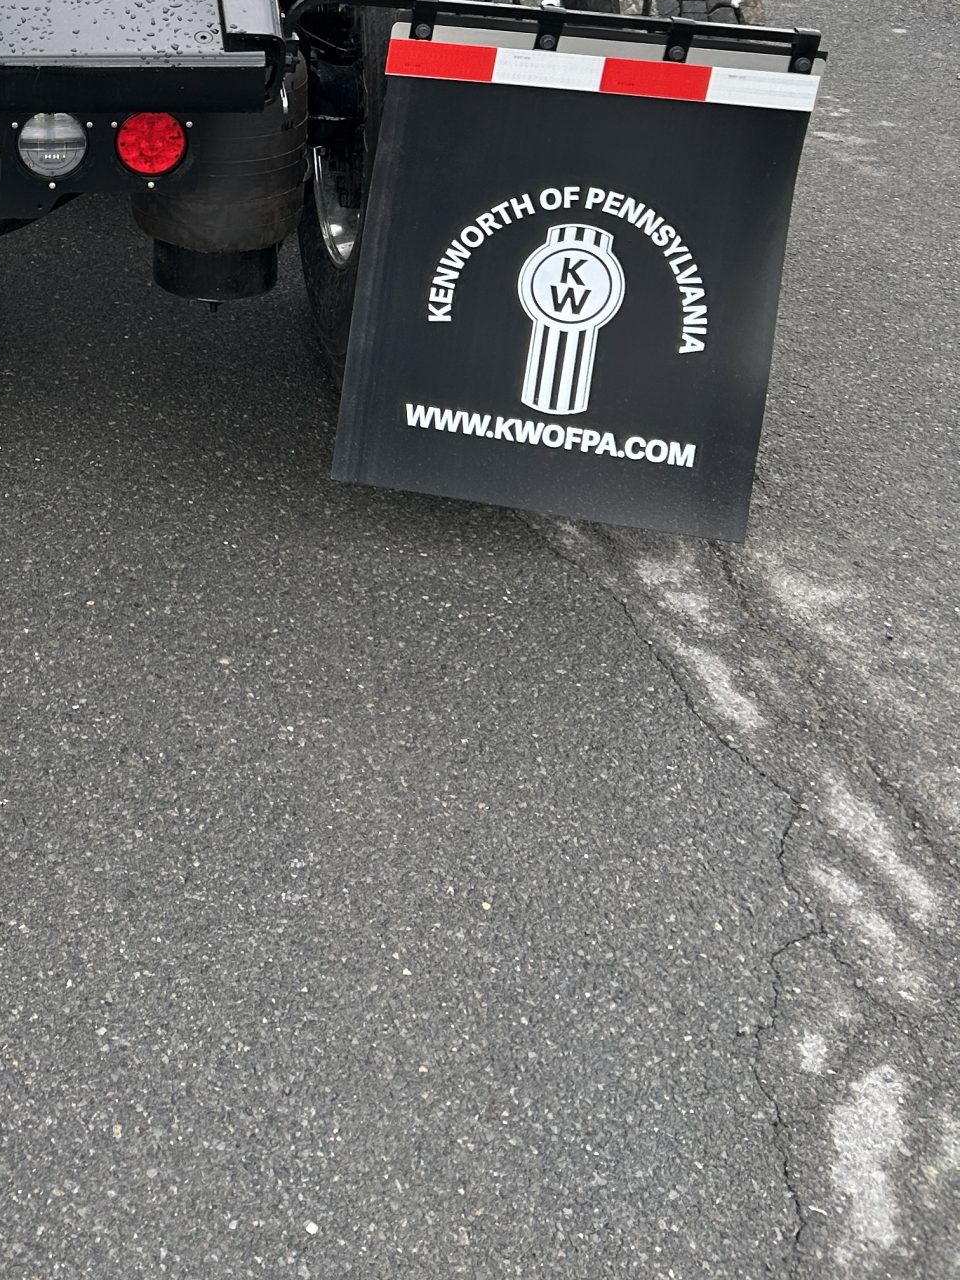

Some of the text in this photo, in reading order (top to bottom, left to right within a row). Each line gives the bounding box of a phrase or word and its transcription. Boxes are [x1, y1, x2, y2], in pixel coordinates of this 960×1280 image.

[427, 186, 708, 354] KENWORTH OF PENNSYLVANIA
[405, 403, 697, 468] WWW.KWOFPA.COM
